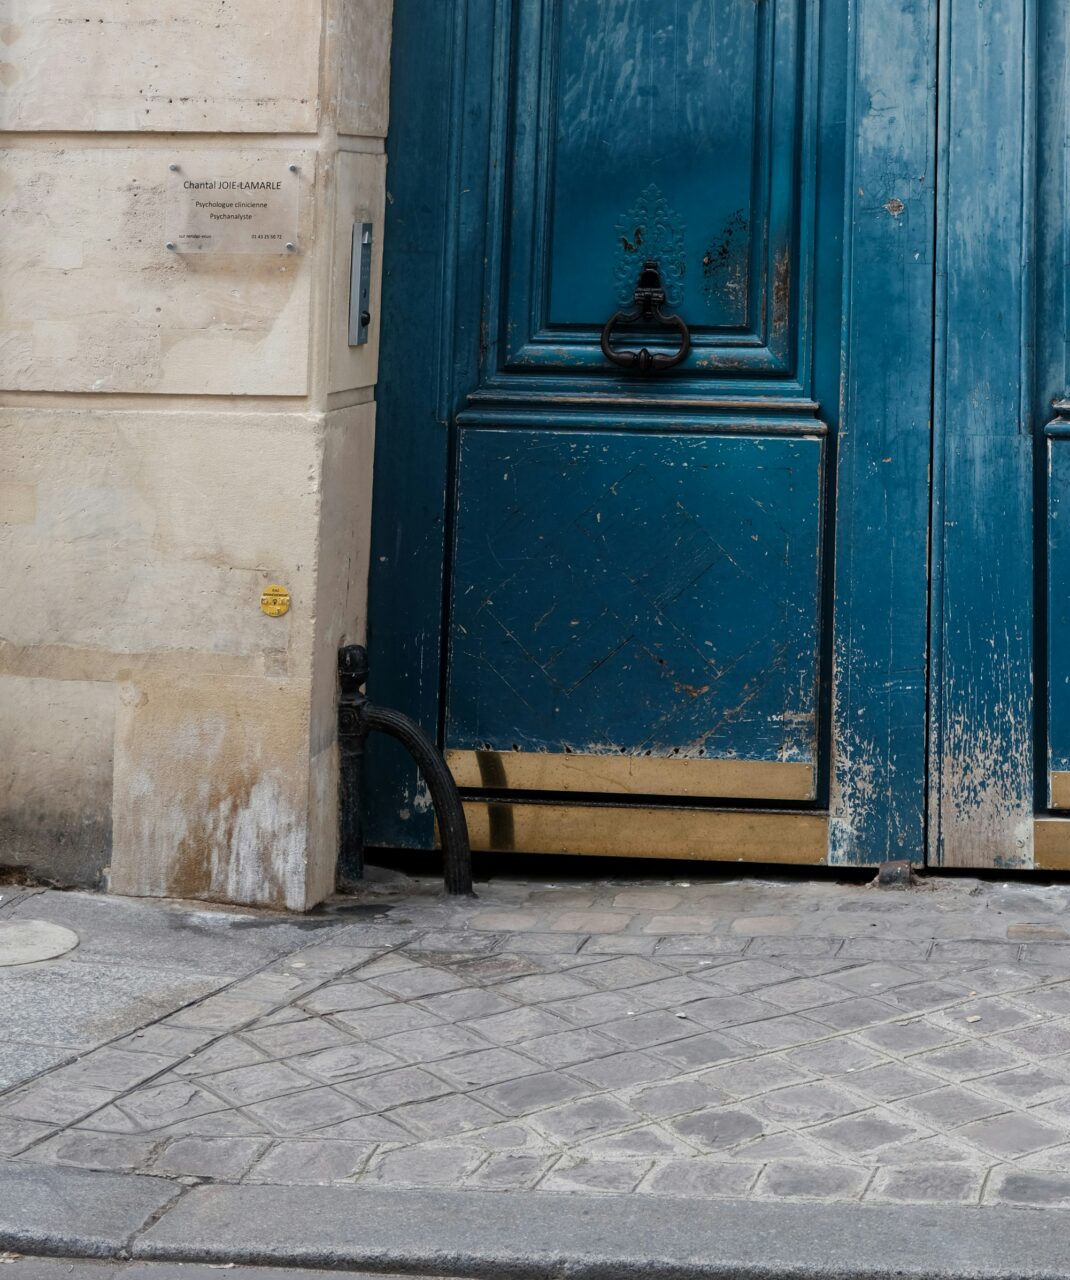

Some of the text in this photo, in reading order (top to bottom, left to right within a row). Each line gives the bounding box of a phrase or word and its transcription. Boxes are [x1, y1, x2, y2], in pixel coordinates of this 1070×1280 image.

[183, 180, 281, 190] Chantal JOIE-LAMARLE
[195, 201, 268, 209] Psychologue clinicienne
